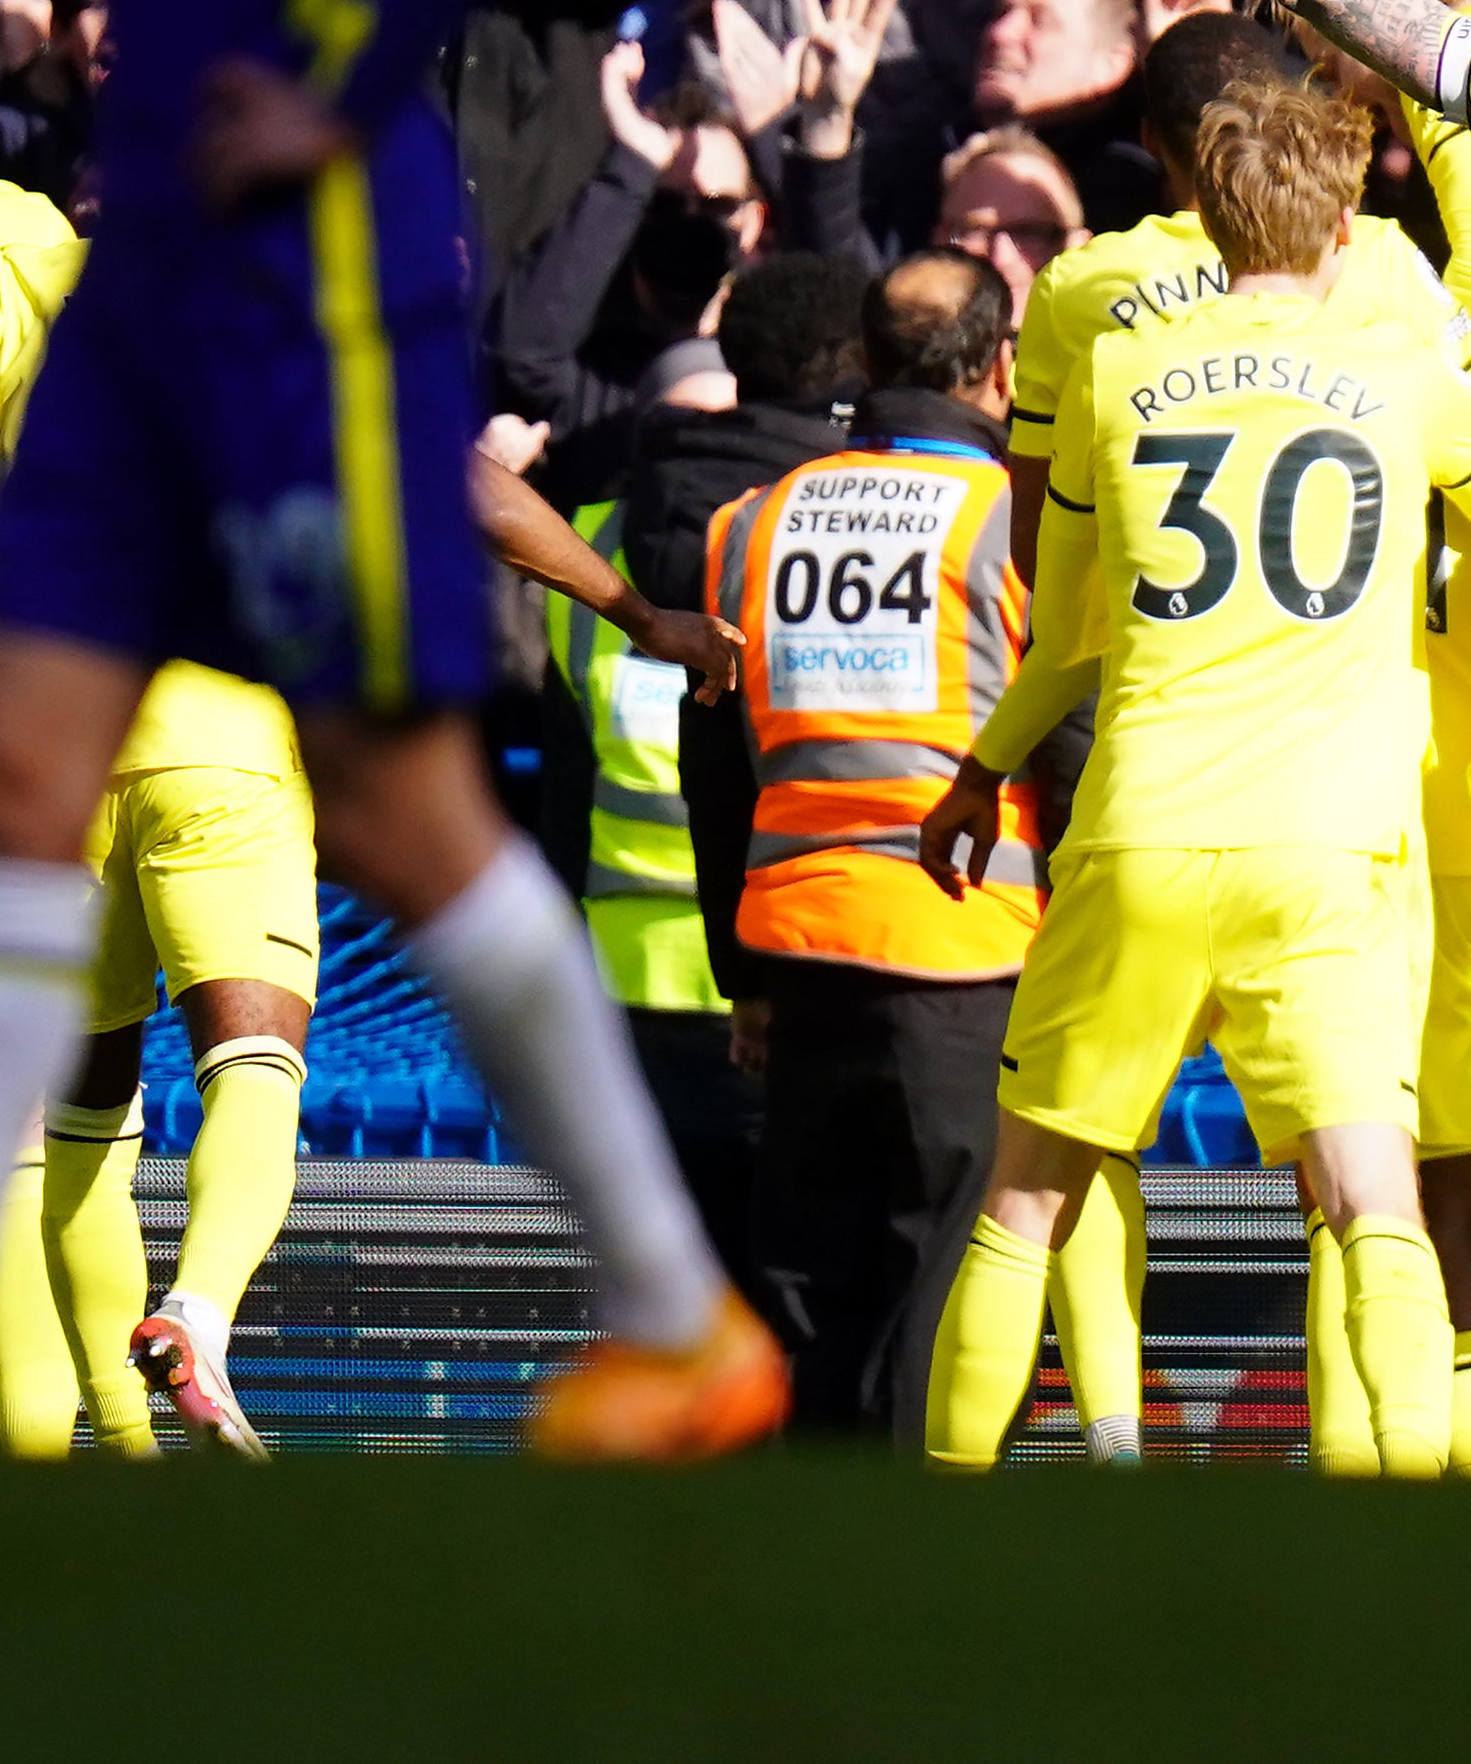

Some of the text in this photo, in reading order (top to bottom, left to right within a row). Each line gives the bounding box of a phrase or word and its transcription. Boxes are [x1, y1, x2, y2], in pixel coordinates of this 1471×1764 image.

[1130, 354, 1385, 422] ROERSLEV
[799, 477, 949, 503] SUPPORT
[787, 510, 938, 533] STEWARD
[1131, 428, 1383, 620] 30
[774, 550, 932, 625] 064
[784, 646, 909, 671] servoca
